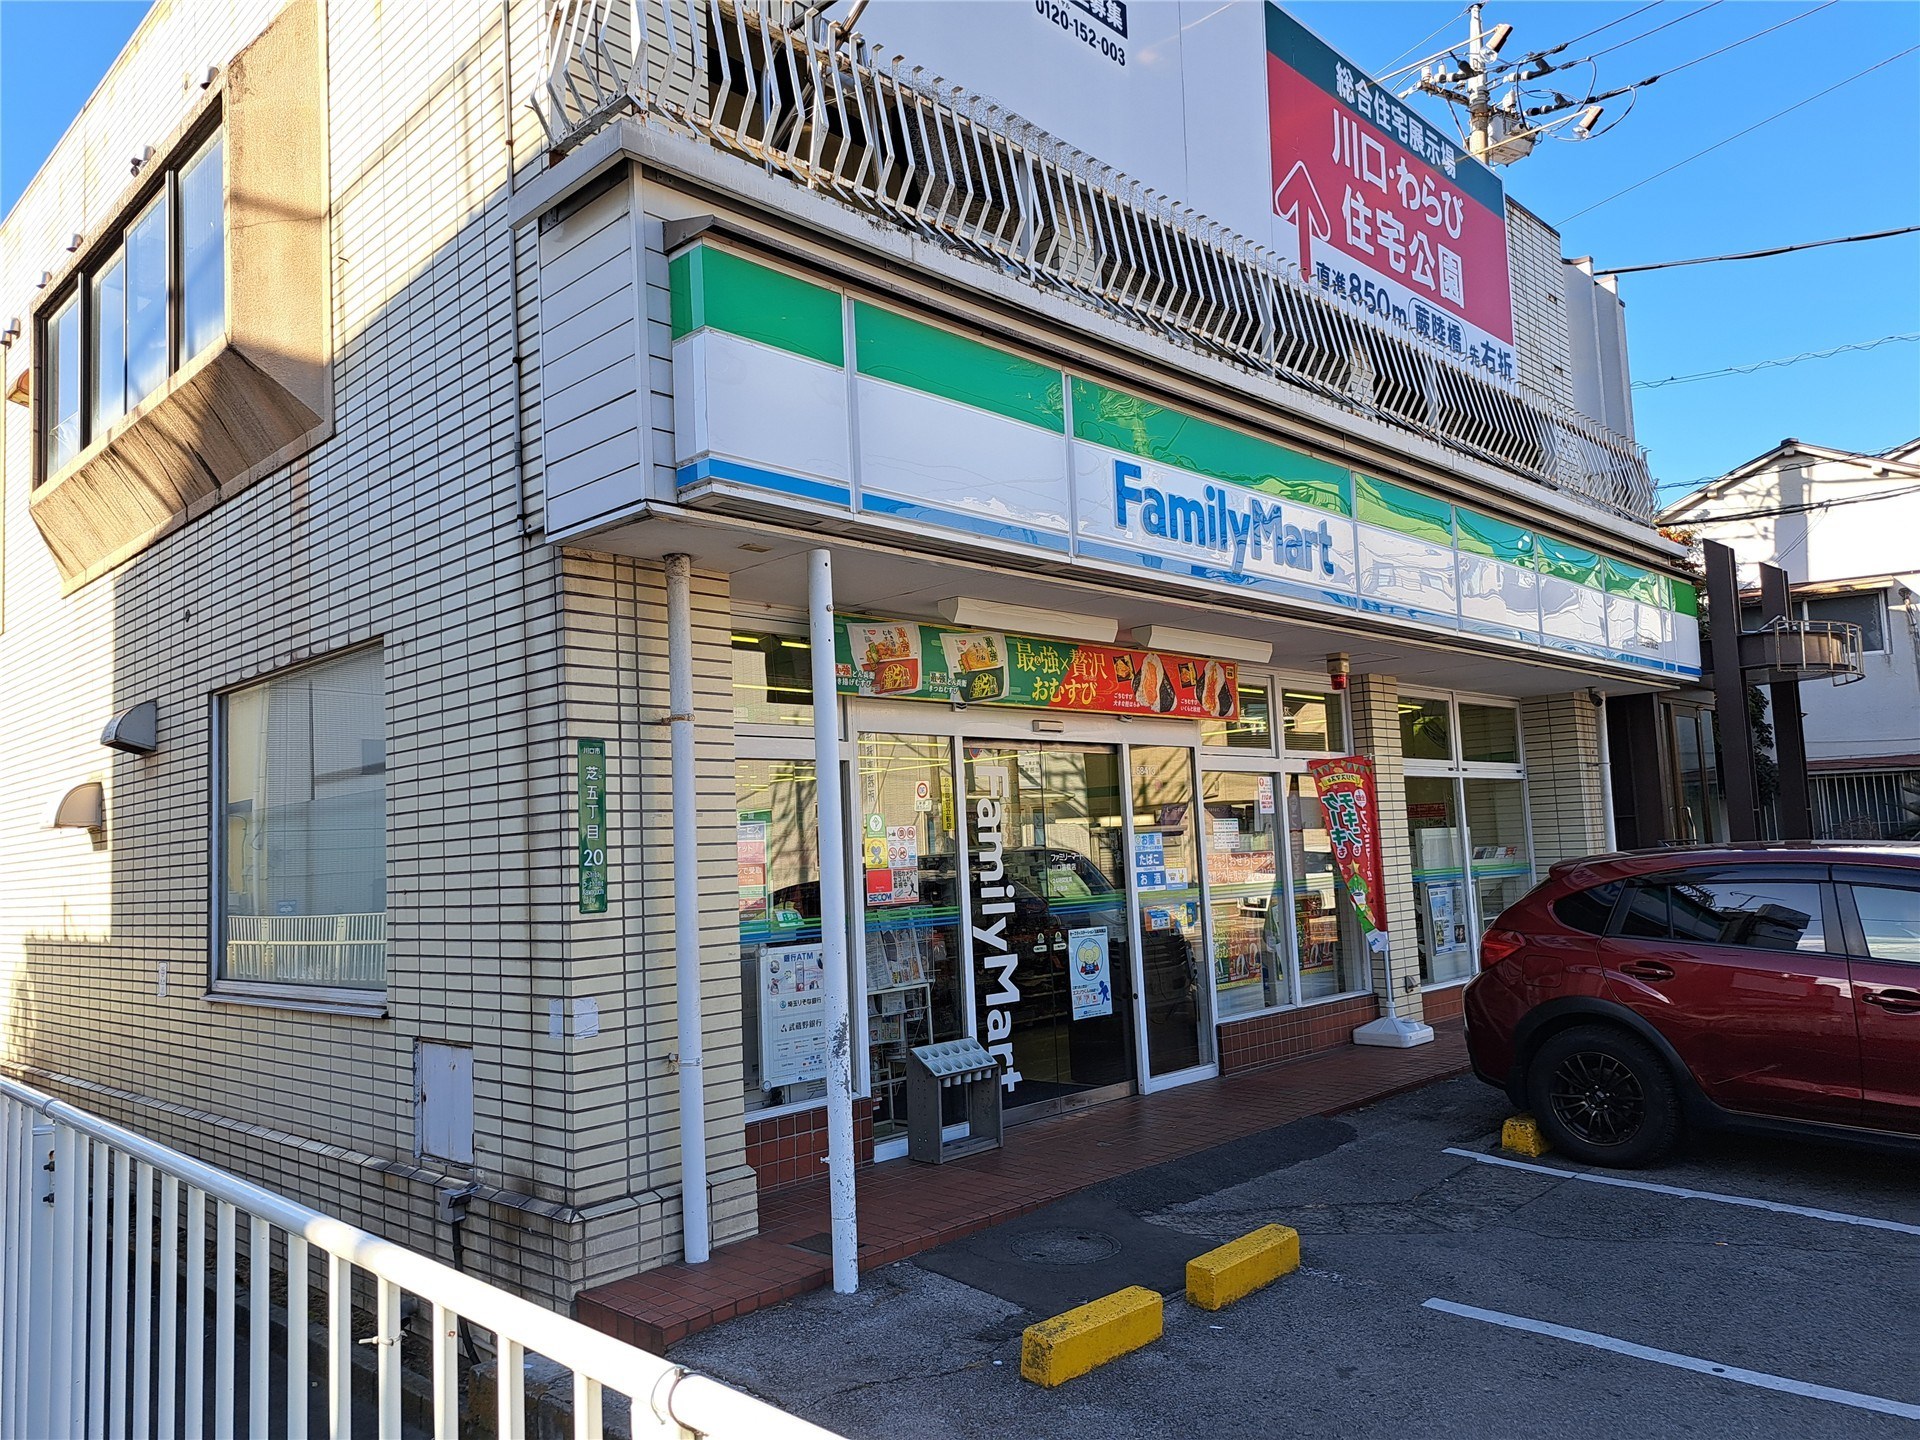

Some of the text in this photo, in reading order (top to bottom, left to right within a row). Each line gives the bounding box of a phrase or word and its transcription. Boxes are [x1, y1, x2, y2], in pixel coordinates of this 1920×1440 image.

[1036, 0, 1126, 67] 0120-152-003
[1335, 61, 1457, 180] 総合住宅展示場
[1341, 184, 1465, 310] 住宅公園
[1114, 458, 1335, 575] FamilyMart
[1031, 676, 1098, 705] おむすび
[583, 747, 601, 755] 川口市
[585, 765, 600, 840] 芝五丁目
[583, 850, 604, 867] 20
[1050, 853, 1083, 862] ファミリーマート
[1139, 853, 1160, 866] たばこ
[868, 893, 893, 902] SECOM
[973, 766, 1023, 1093] FamilyMart
[783, 952, 814, 963] 銀行ATM
[787, 997, 822, 1008] 埼玉りそな銀行
